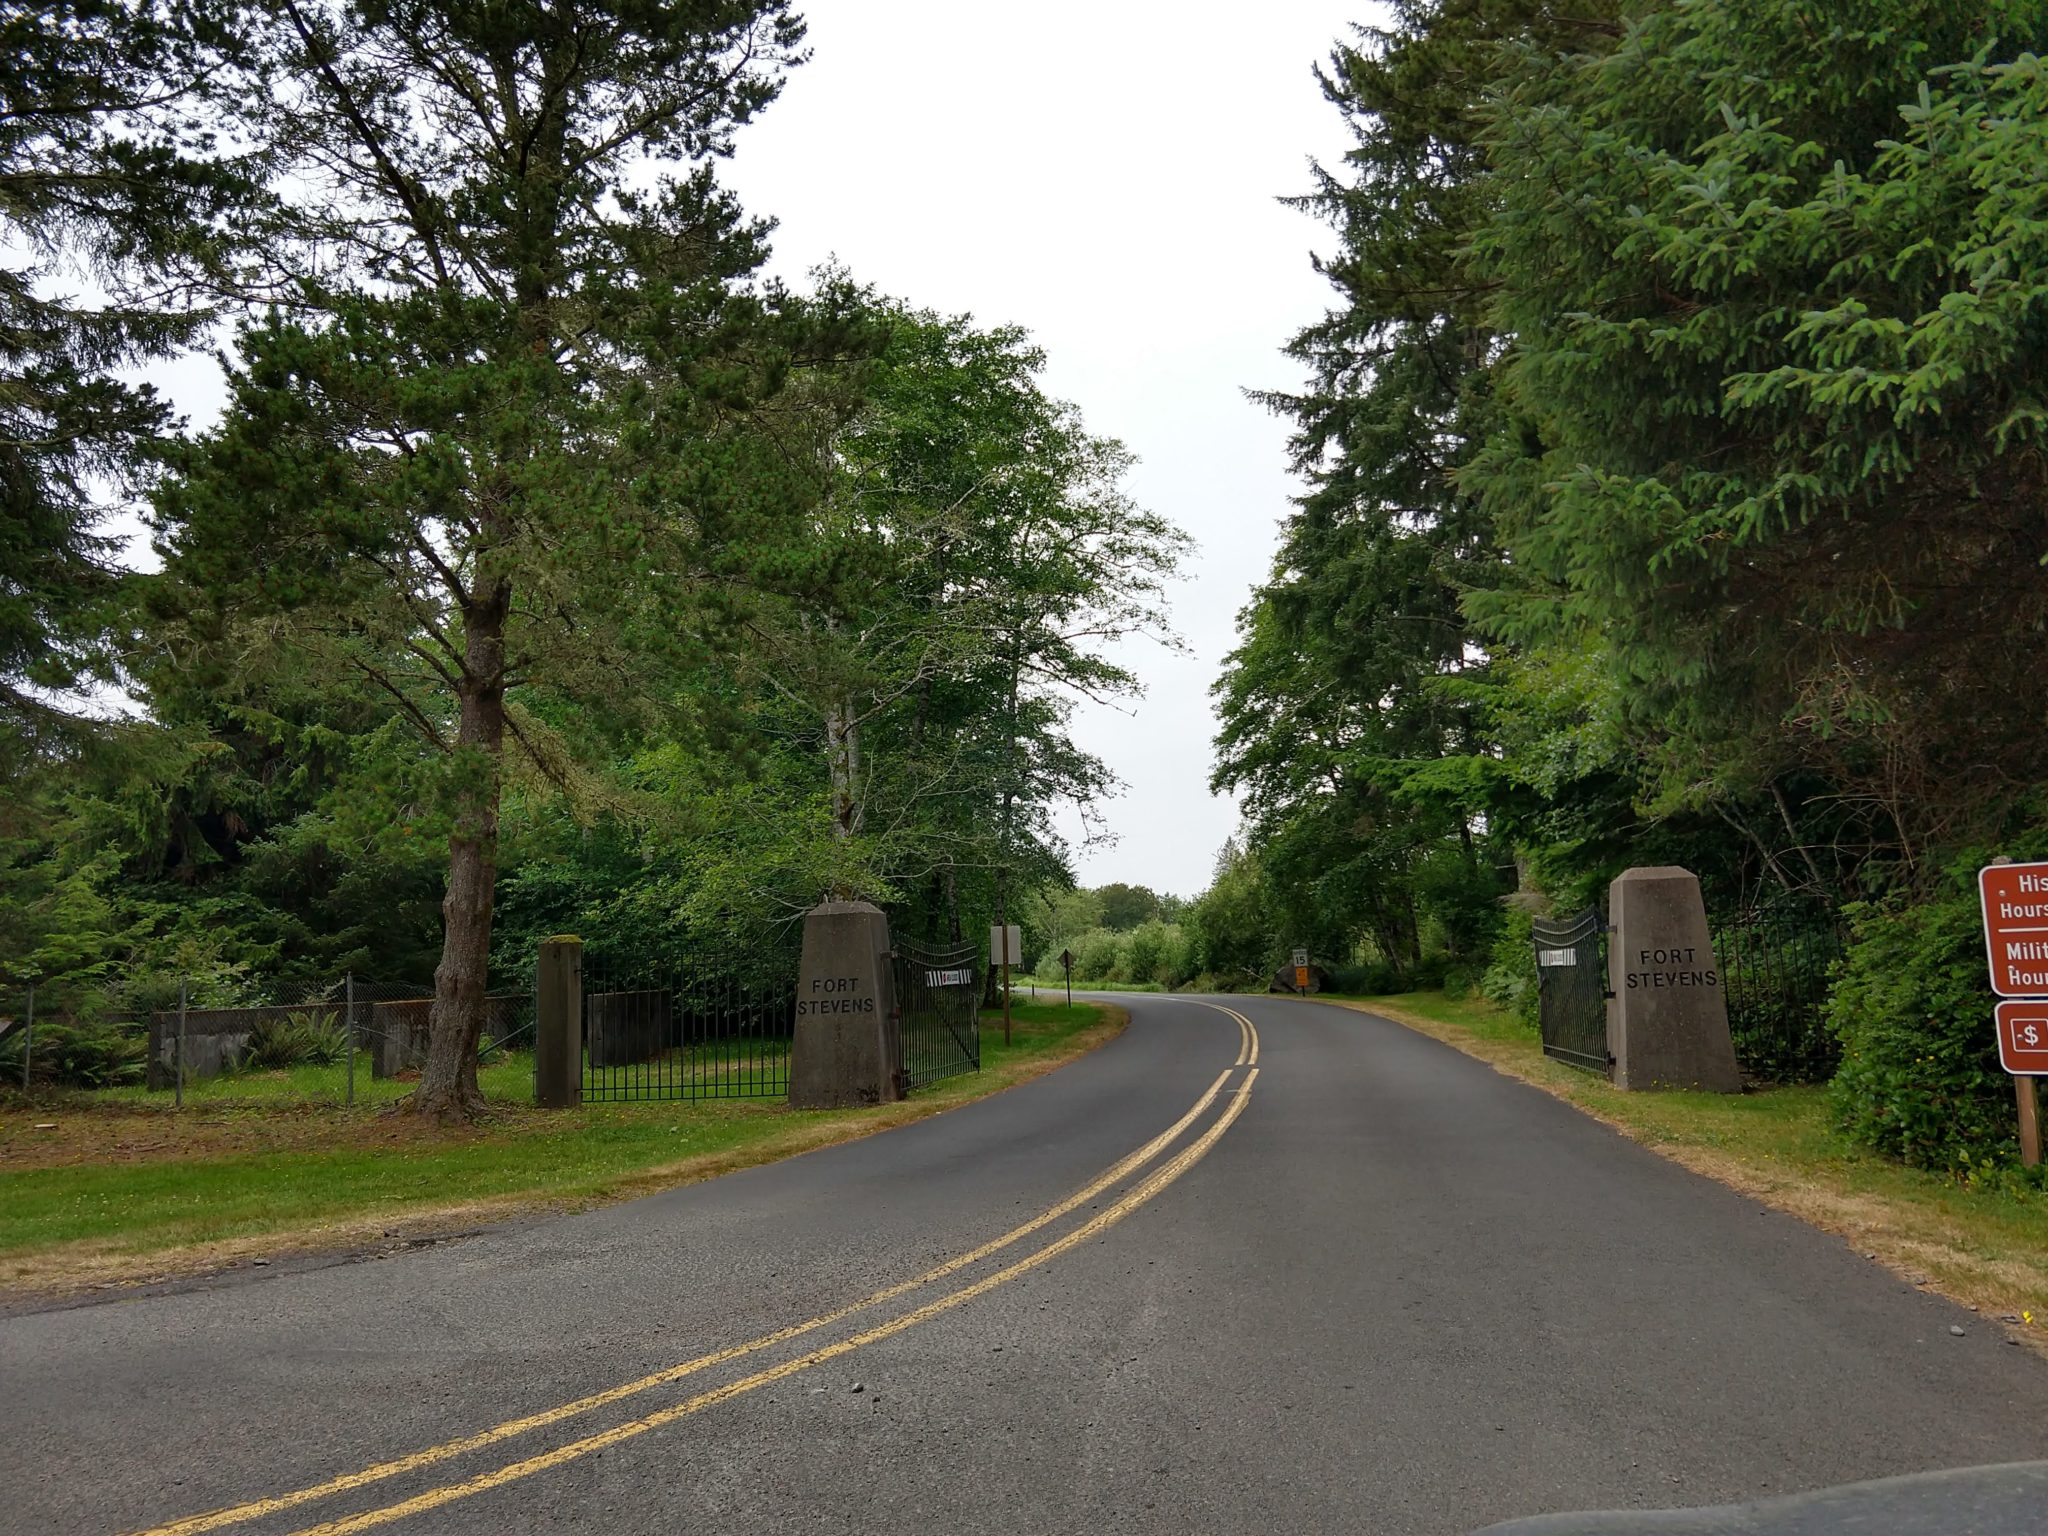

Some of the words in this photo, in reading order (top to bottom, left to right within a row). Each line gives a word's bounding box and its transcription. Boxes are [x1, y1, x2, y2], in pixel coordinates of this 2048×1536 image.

[1295, 955, 1306, 965] 15
[1640, 948, 1696, 965] FORT
[812, 978, 859, 993] FORT
[1626, 970, 1717, 989] STEVENS
[797, 998, 873, 1015] STEVENS
